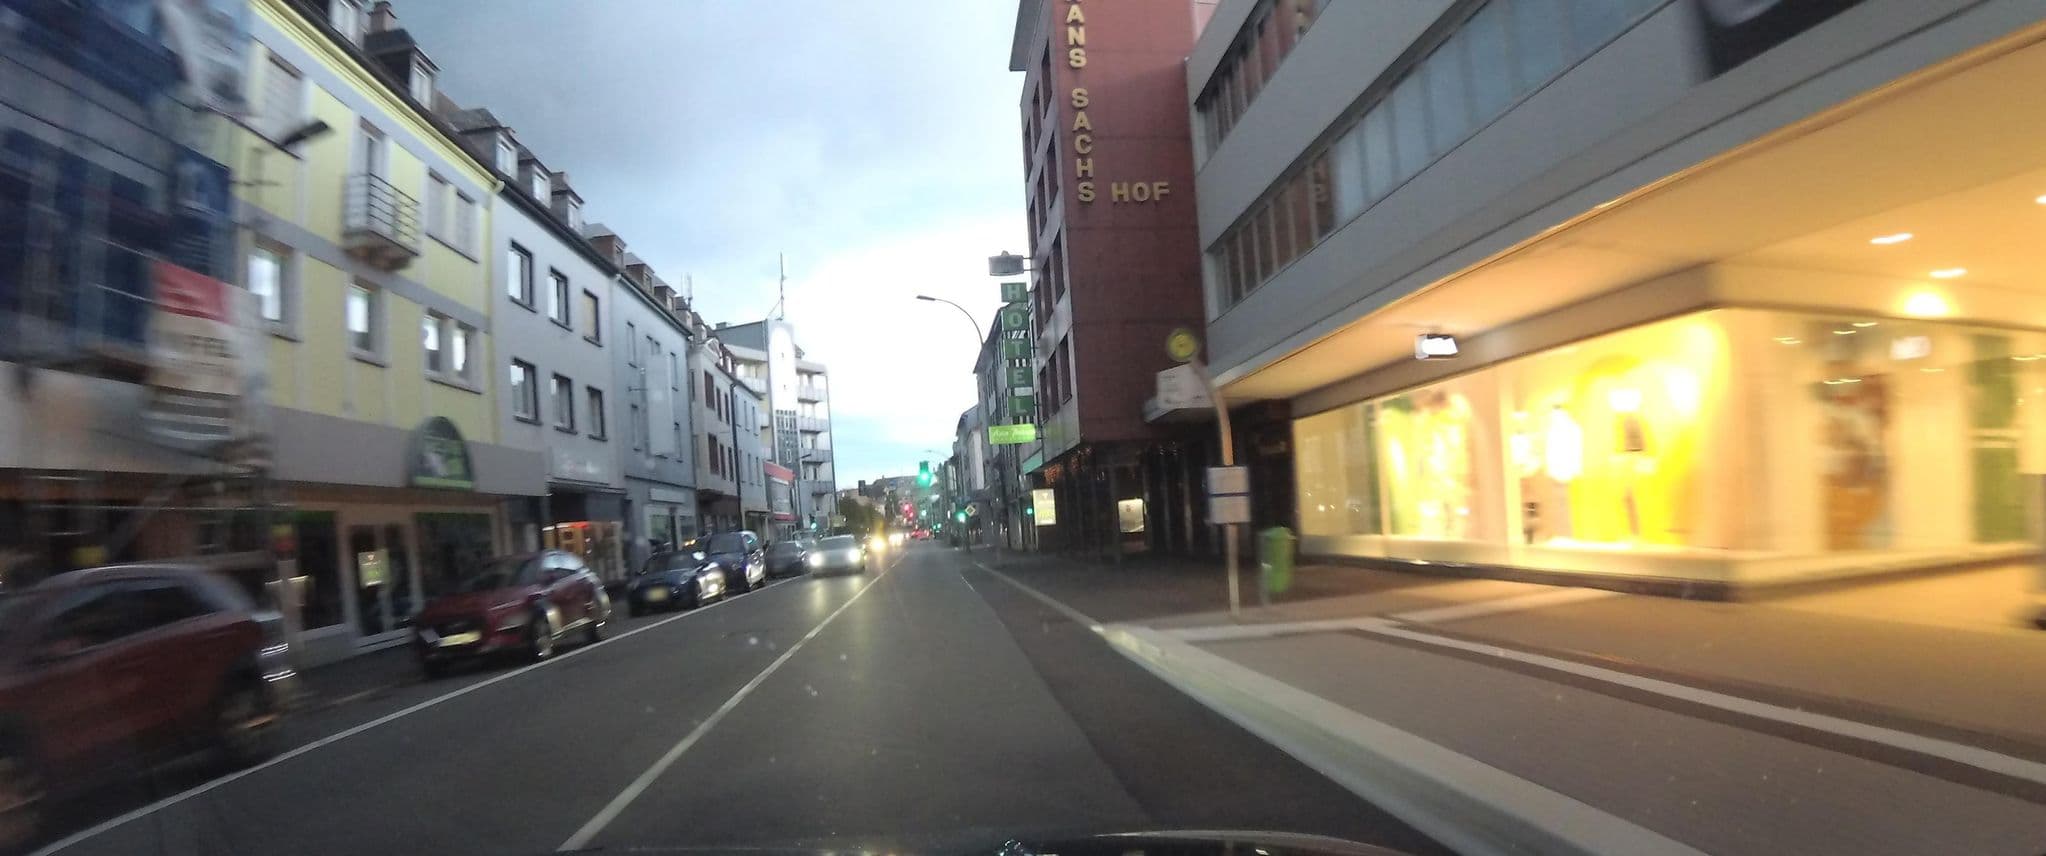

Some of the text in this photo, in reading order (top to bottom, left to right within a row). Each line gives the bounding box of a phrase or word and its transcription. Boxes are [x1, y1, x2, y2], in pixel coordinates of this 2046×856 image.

[1066, 0, 1096, 202] ANS SACHS
[1111, 182, 1170, 203] HOF
[1006, 282, 1028, 414] HOTEL
